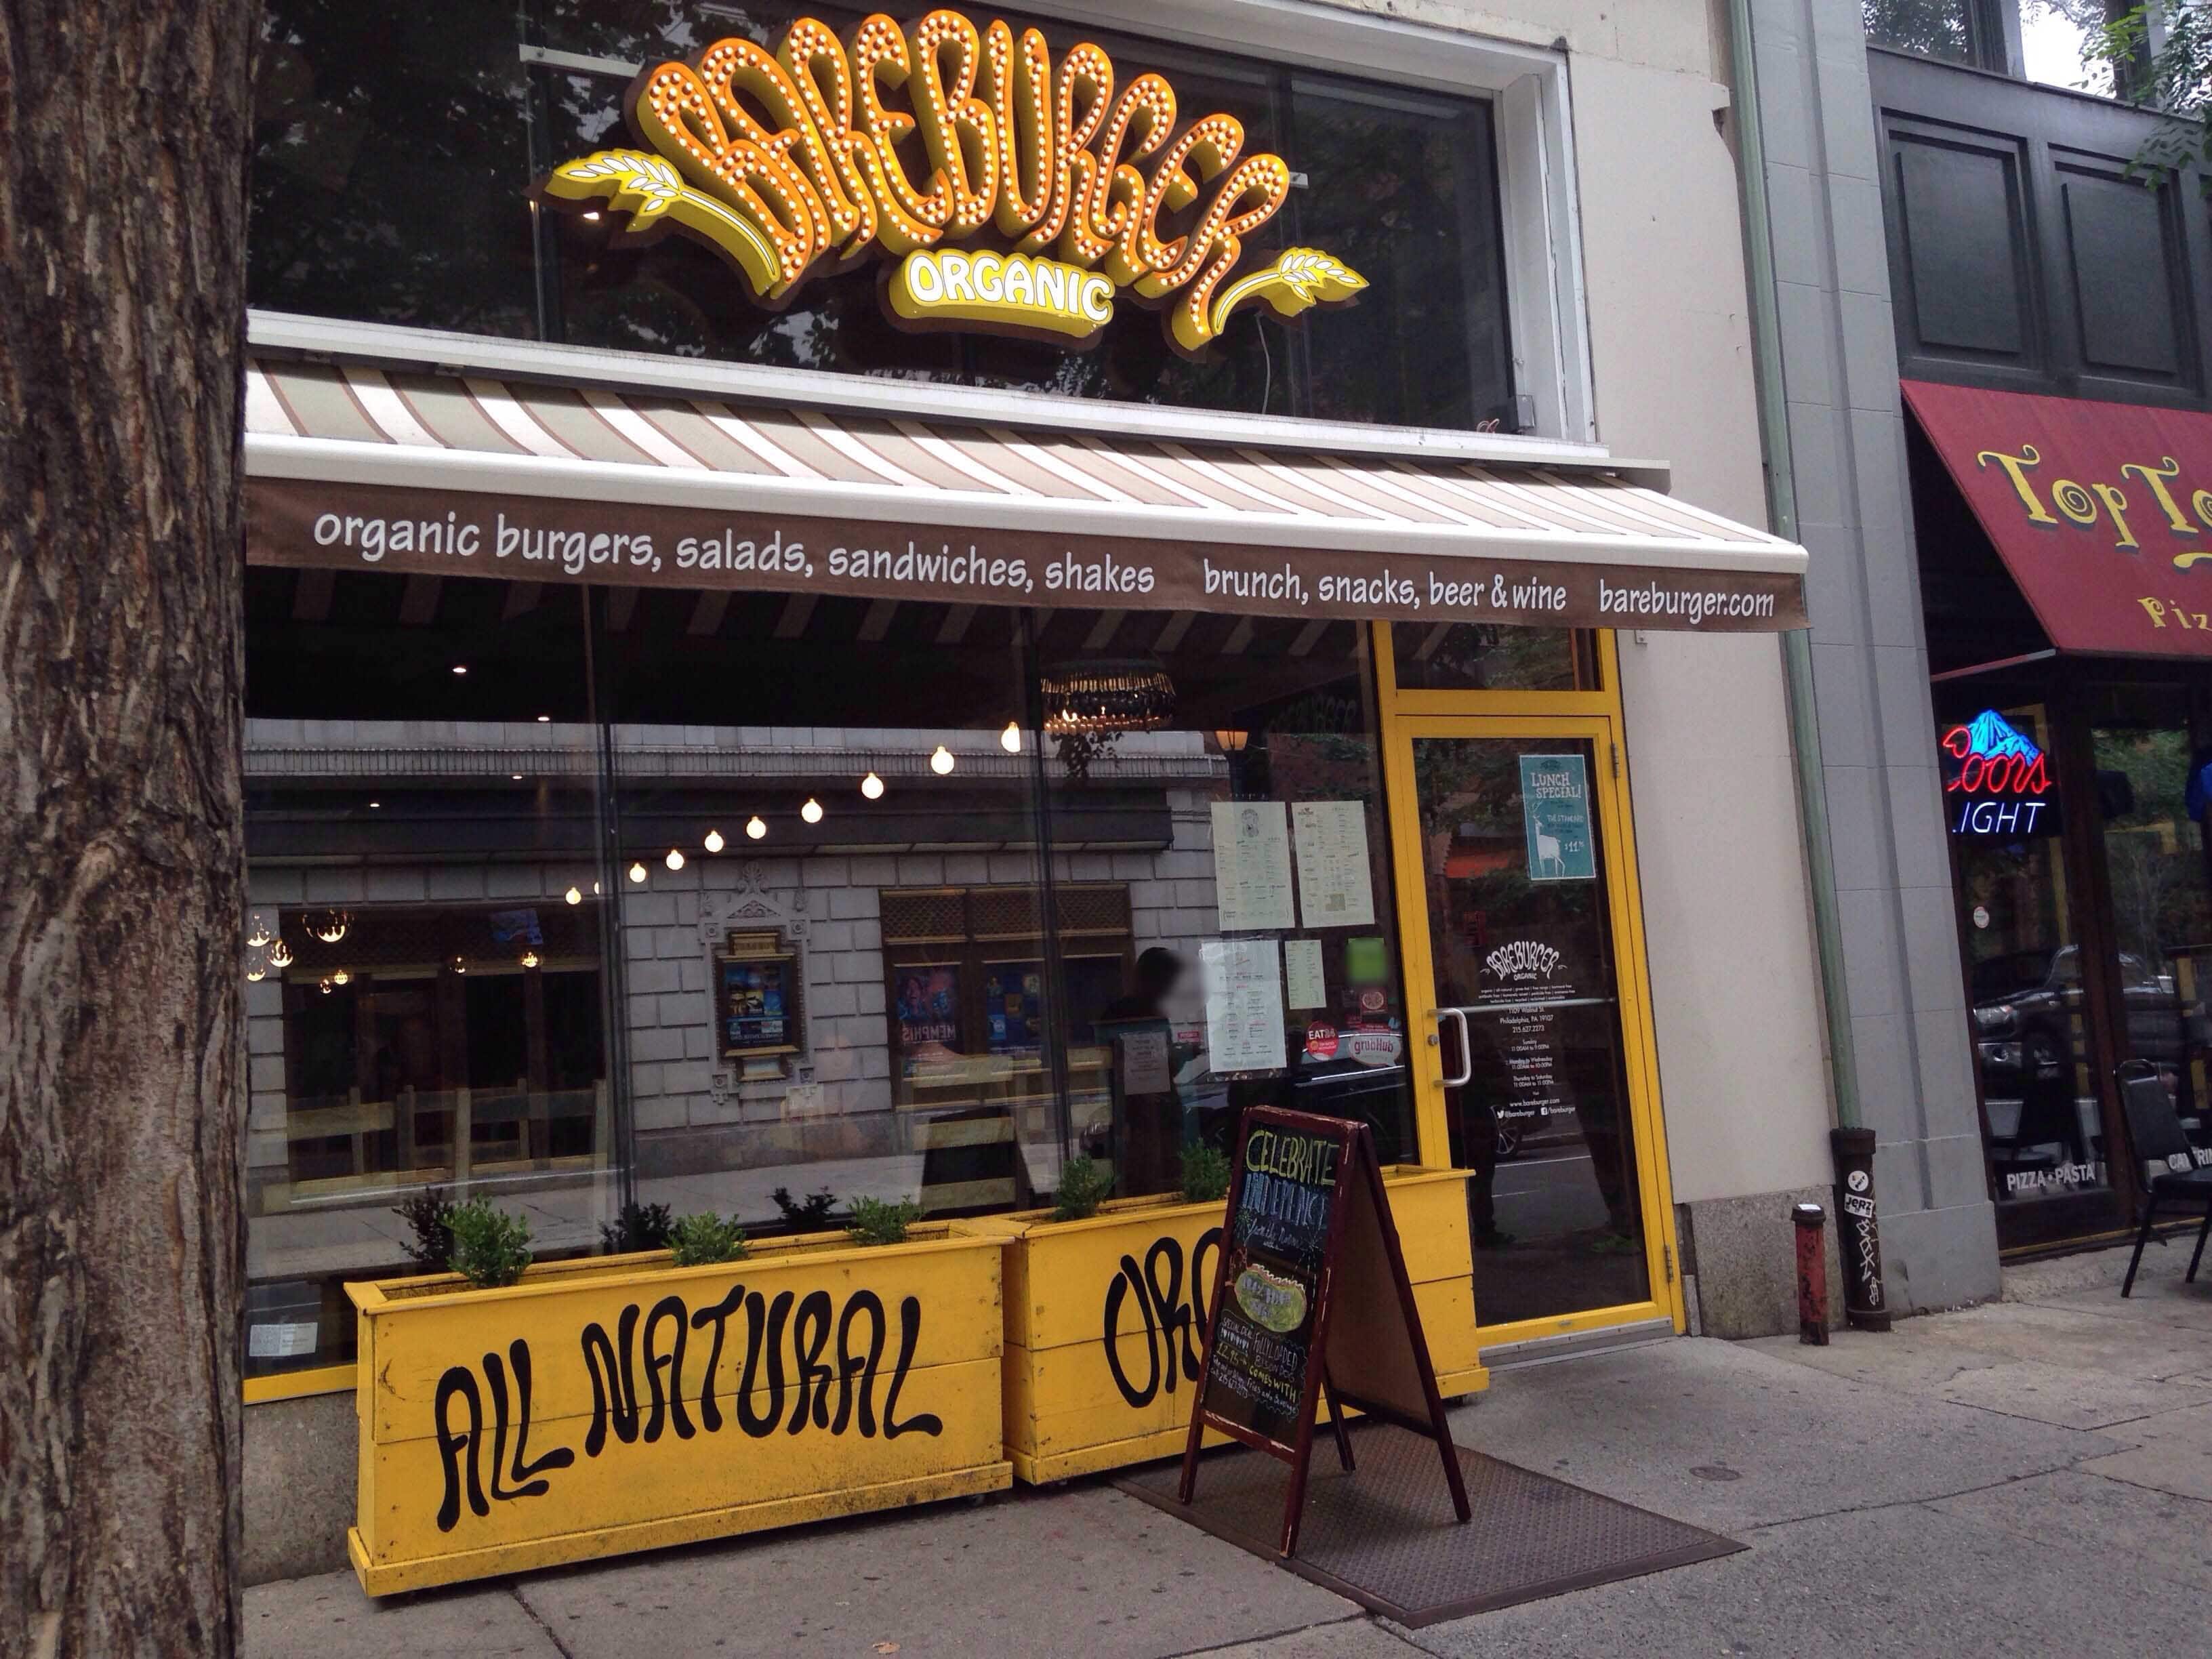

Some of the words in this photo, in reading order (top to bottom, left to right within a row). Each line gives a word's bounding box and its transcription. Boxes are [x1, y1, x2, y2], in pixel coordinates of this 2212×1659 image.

[640, 9, 1290, 344] BAREBURGER
[909, 251, 1115, 325] ORGANIC
[1977, 444, 2139, 549] Top
[314, 510, 481, 562] organic
[495, 513, 663, 575] burgers,
[676, 528, 815, 579] salads,
[828, 541, 1035, 594] sandwiches,
[1044, 551, 1155, 594] shakes
[1204, 558, 1309, 607] brunch,
[1318, 569, 1421, 609] snacks,
[1429, 571, 1485, 607] beer
[1512, 577, 1568, 611] wine
[1599, 578, 1776, 626] bareburger.com
[1530, 772, 1571, 787] LUNCH
[1942, 725, 2052, 794] Coors
[1536, 784, 1582, 799] SPECIAL!
[1952, 802, 2046, 834] IGHT
[1486, 941, 1559, 981] BAREBURGER
[1513, 972, 1537, 981] ORGANIC
[1509, 1098, 1560, 1107] www.bareburger.com
[1246, 1130, 1340, 1185] CELEBRATE
[2007, 1170, 2046, 1191] PIZZA
[2054, 1164, 2096, 1185] PASTA
[1248, 1366, 1273, 1387] COMES
[1273, 1378, 1296, 1404] WITH
[435, 1337, 575, 1534] ALL
[581, 1283, 943, 1460] NATURAL
